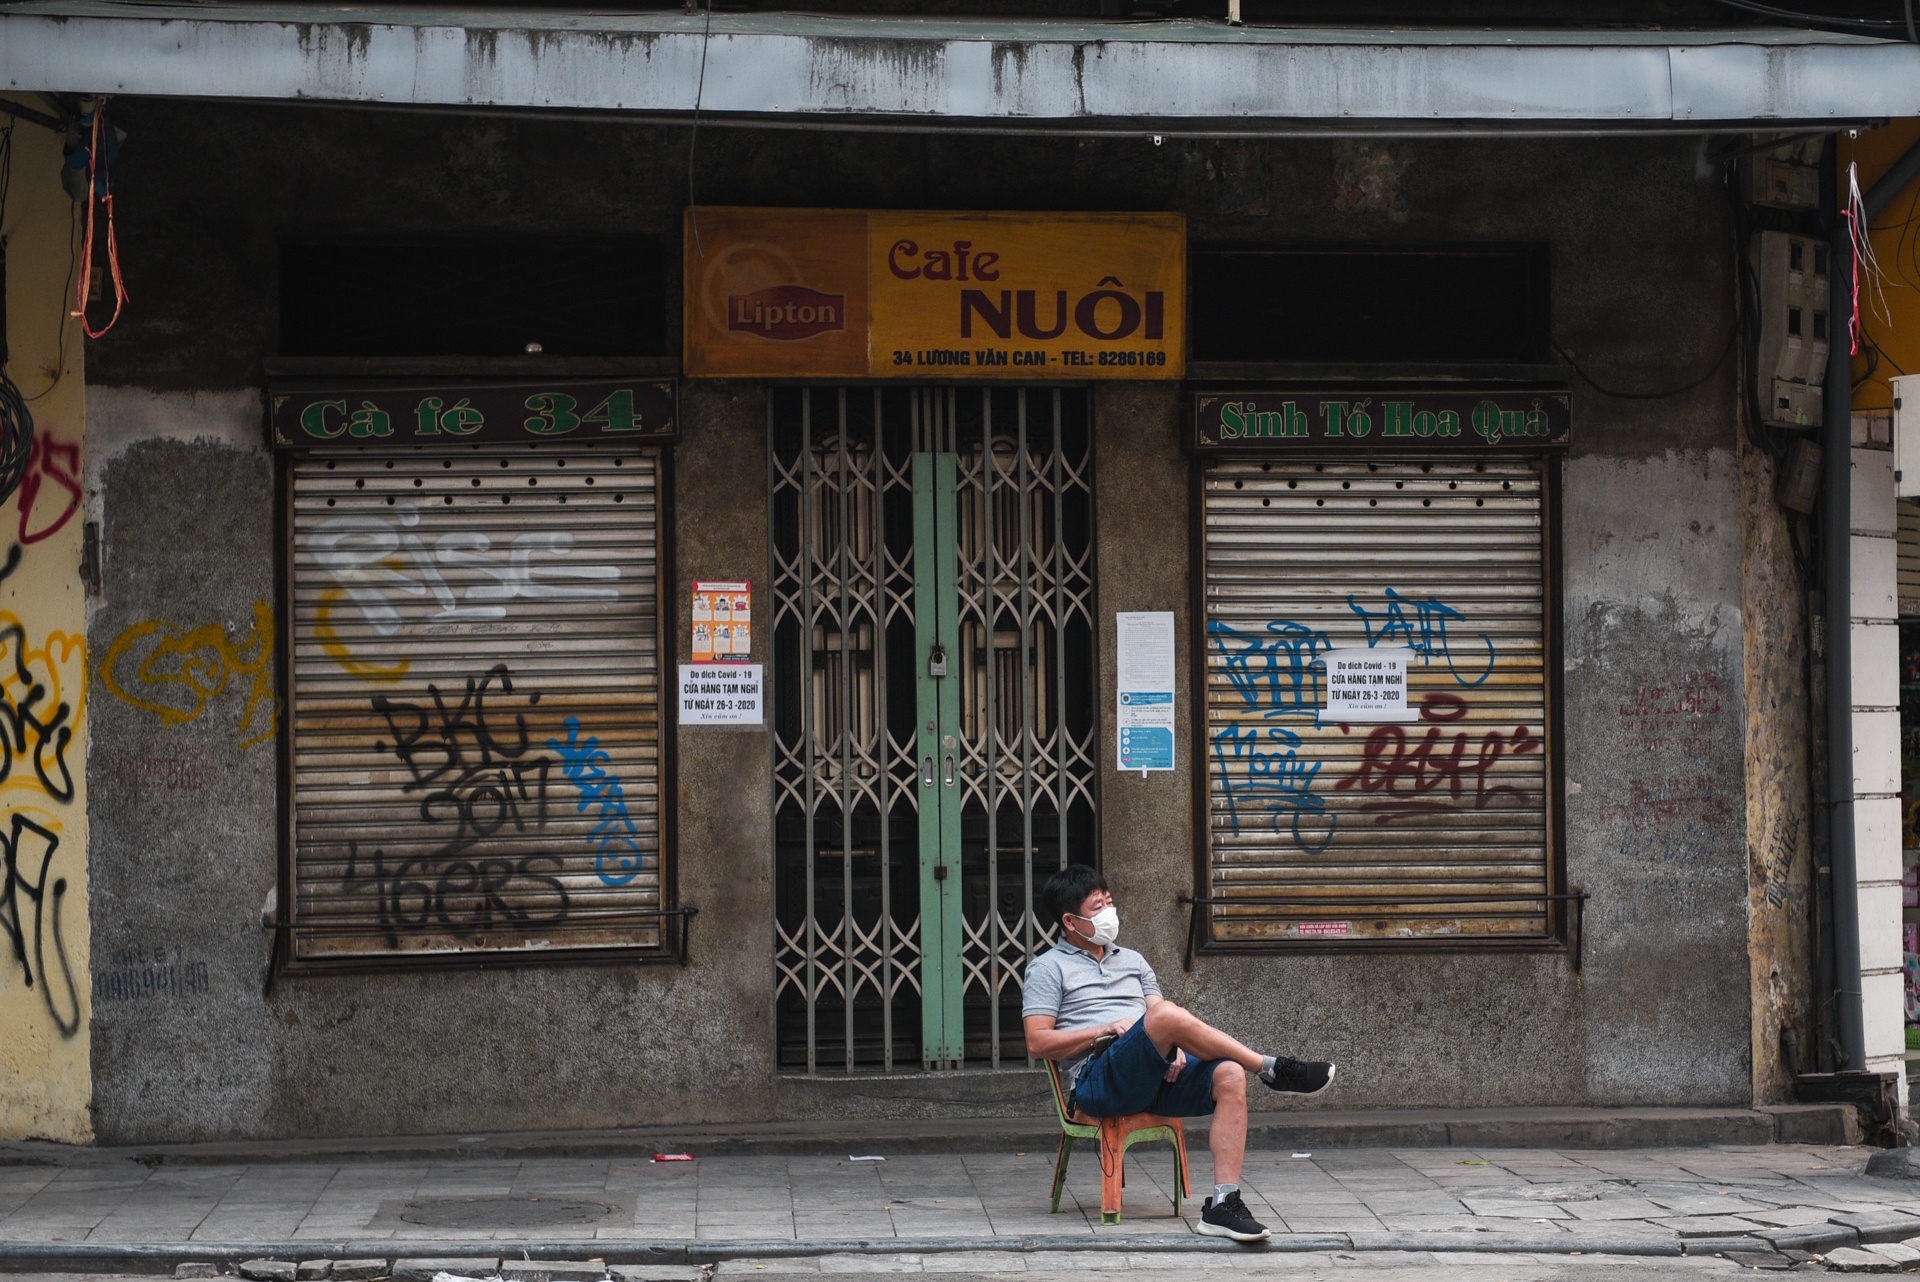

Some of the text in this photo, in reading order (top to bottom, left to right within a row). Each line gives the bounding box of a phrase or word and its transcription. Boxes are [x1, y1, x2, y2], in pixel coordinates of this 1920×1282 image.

[888, 240, 1000, 282] Cafe
[736, 297, 836, 330] Lipton
[960, 276, 1164, 340] NUÔI
[893, 350, 913, 366] 34
[975, 347, 1008, 366] VĂN
[1012, 350, 1046, 366] CAN
[1062, 350, 1094, 366] TEL:
[1098, 350, 1166, 366] 8286169
[301, 388, 642, 439] Cà fé 34
[1220, 397, 1551, 445] Sinh Tố Hoa Quả
[690, 670, 699, 679] Do
[718, 670, 737, 679] Covid
[744, 670, 752, 679] 19
[1338, 662, 1346, 670] Do
[1364, 662, 1382, 670] Covid
[1388, 662, 1396, 670] 19
[1332, 671, 1402, 686] CỬA HÀNG TẠM NGHỈ
[684, 680, 758, 696] CỬA HÀNG TẠM NGHỈ
[1342, 688, 1361, 700] NGÀY
[1362, 690, 1378, 700] 26-3
[695, 698, 714, 710] NGÀY
[716, 700, 732, 710] 26-3
